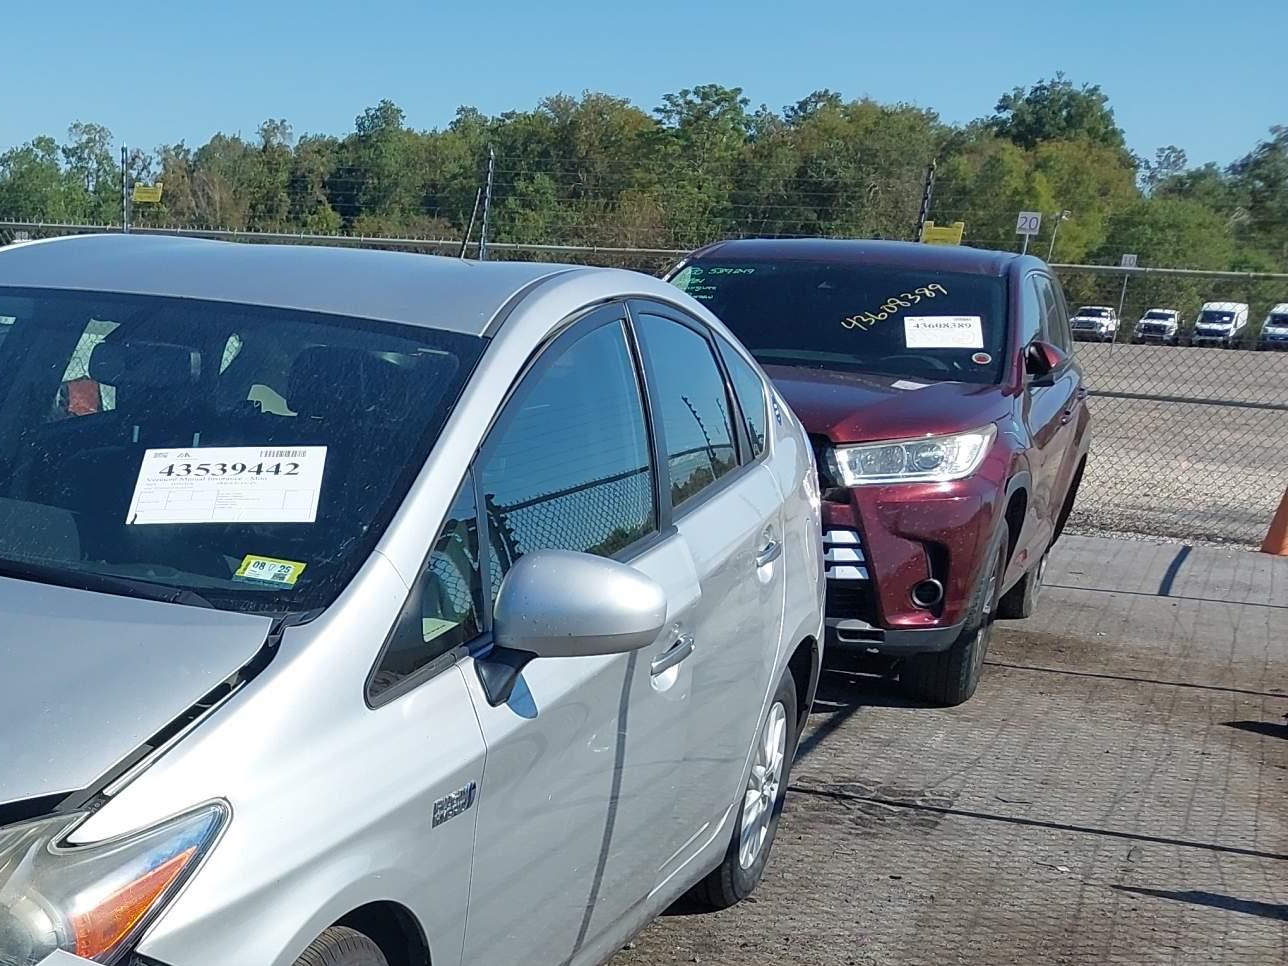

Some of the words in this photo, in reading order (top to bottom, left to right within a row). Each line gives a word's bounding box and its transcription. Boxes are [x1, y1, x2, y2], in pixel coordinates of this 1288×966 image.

[1018, 216, 1039, 231] 20
[840, 283, 948, 332] 43608389
[158, 462, 300, 477] 43539442
[252, 560, 267, 571] 08
[277, 564, 292, 574] 25
